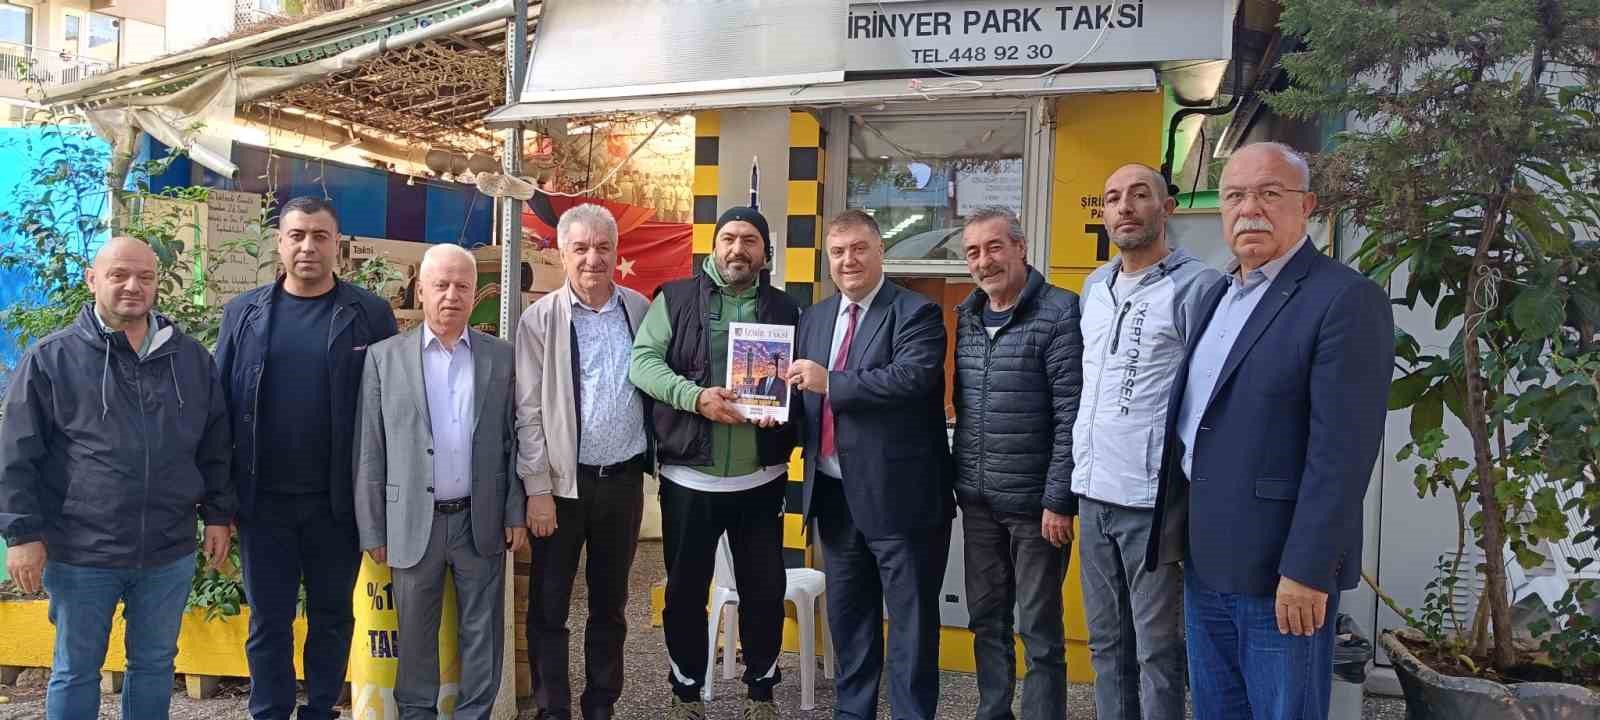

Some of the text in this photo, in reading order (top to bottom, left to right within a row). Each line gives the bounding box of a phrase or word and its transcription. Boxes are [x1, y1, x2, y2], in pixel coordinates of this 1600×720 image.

[963, 8, 1042, 34] PARK
[1056, 1, 1143, 31] TAKSİ
[912, 44, 1053, 63] TEL.448 92 30
